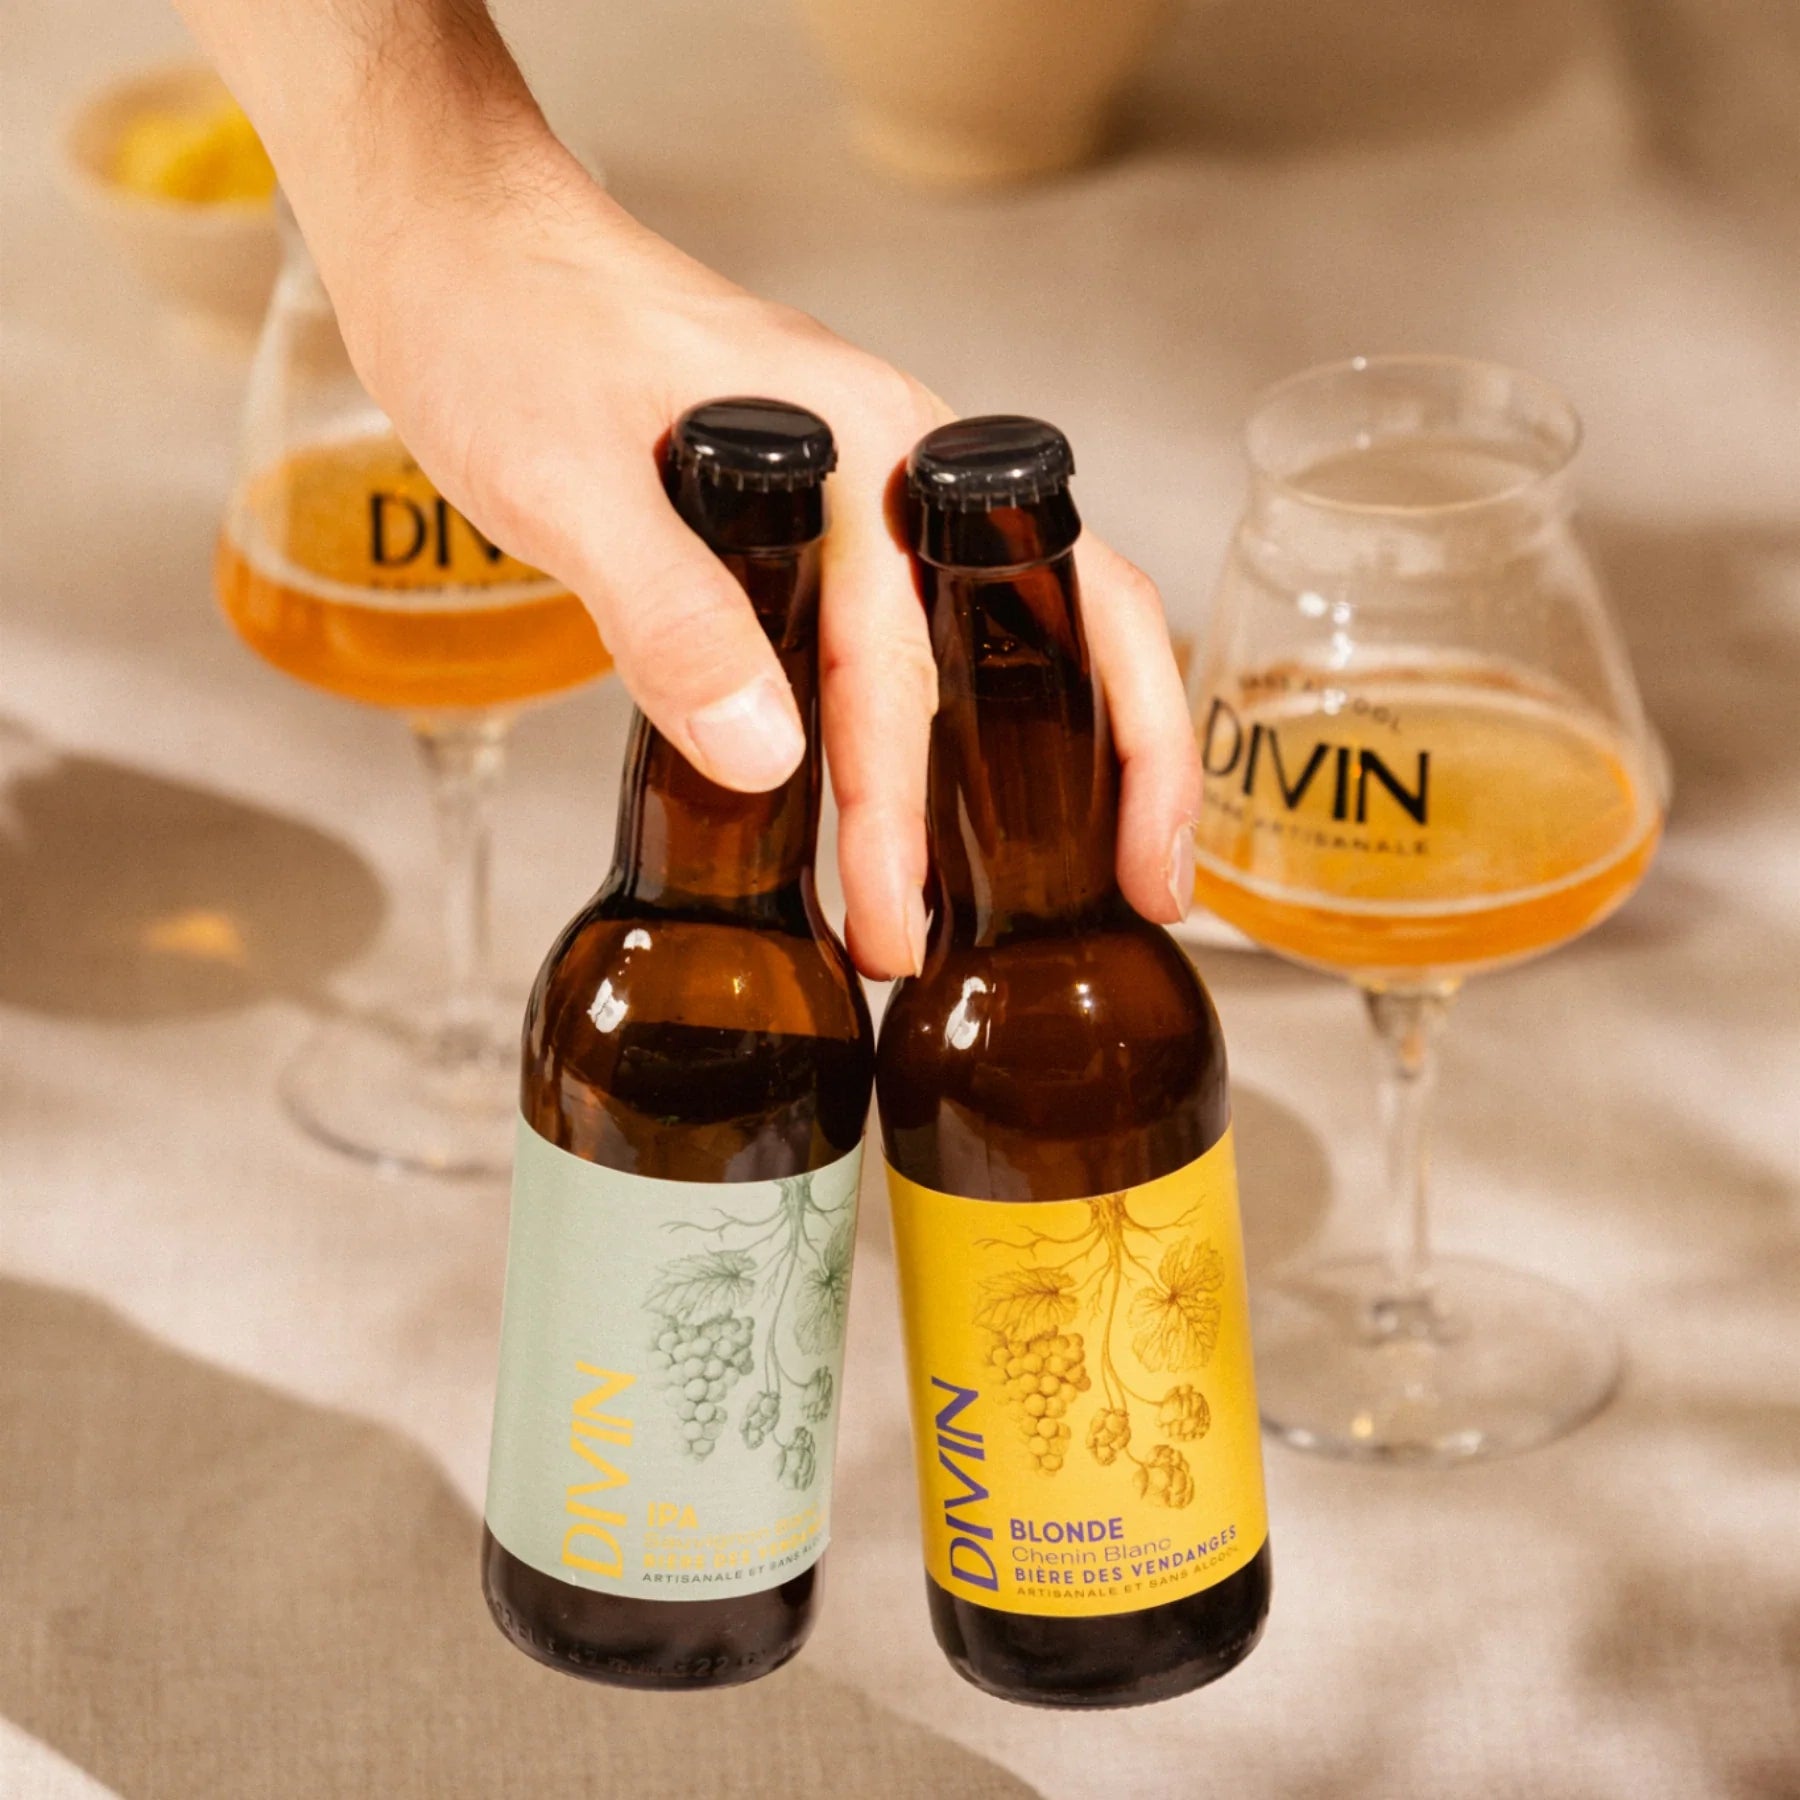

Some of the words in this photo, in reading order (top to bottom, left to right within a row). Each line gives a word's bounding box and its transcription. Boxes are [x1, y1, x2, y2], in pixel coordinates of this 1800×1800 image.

[1203, 697, 1430, 825] DIVIN
[561, 1360, 637, 1580] DIVIN
[931, 1376, 999, 1592] DIVIN
[646, 1501, 699, 1530] IPA
[1010, 1517, 1124, 1544] BLONDE
[714, 1549, 750, 1569] DES
[1012, 1546, 1097, 1566] Chenin
[1104, 1538, 1172, 1563] Blanc
[1015, 1566, 1074, 1585] BIÈRE
[1083, 1567, 1123, 1584] DES
[1131, 1524, 1236, 1577] VENDANGES
[642, 1570, 742, 1584] ARTISANALE
[749, 1565, 764, 1577] ET
[1017, 1587, 1117, 1599] ARTISANALE
[1124, 1582, 1143, 1594] ET
[1149, 1570, 1188, 1589] SANS
